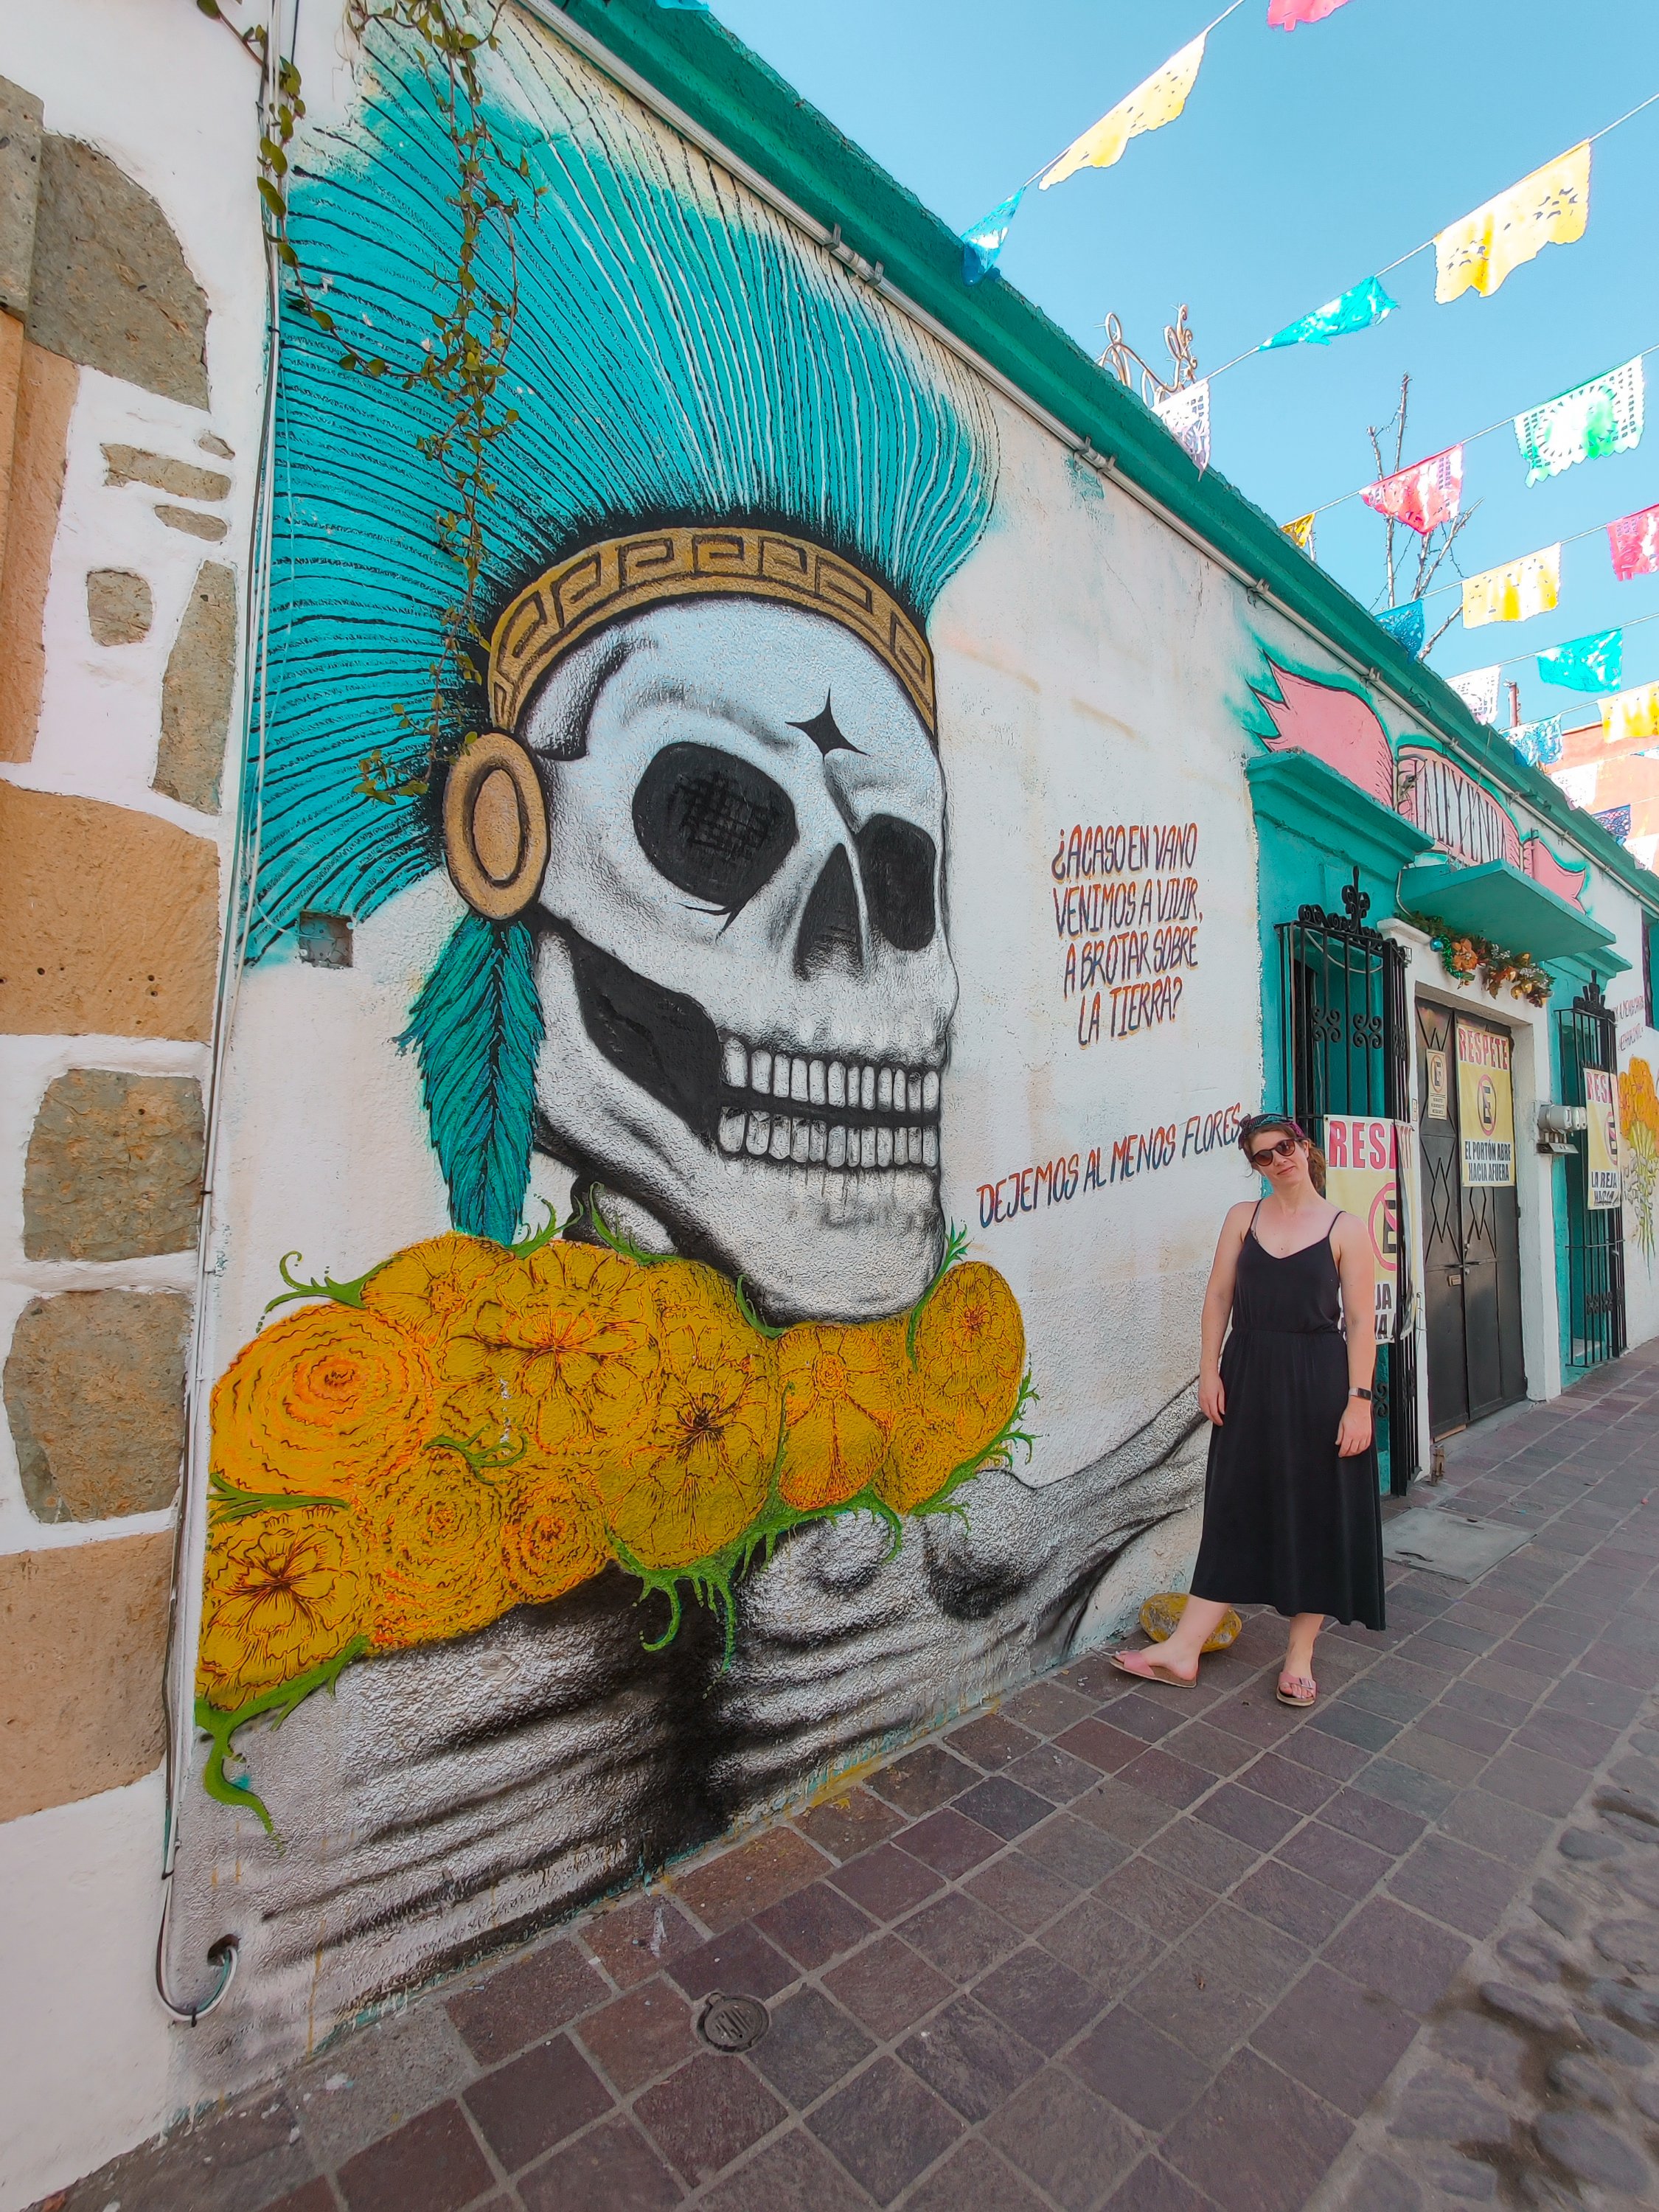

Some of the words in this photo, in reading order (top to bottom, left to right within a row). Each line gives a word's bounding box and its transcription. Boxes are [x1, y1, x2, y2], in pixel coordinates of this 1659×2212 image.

[1051, 824, 1125, 880] ¿ACASO
[1127, 824, 1149, 872] EN
[1153, 822, 1198, 871] VANO
[1053, 880, 1136, 938] VENIMOS
[1138, 878, 1152, 926] A
[1157, 876, 1203, 923] VIVIR,
[1063, 942, 1077, 1000] A
[1080, 930, 1152, 992] BROTAR
[1153, 925, 1198, 973] SOBRE
[1078, 991, 1101, 1046] LA
[1110, 975, 1183, 1038] TIERRA?
[1458, 1028, 1509, 1071] RESPETE
[976, 1153, 1079, 1228] DEJEMOS
[1083, 1147, 1107, 1192] AL
[1110, 1124, 1176, 1183] MENOS
[1182, 1102, 1242, 1158] FLORES
[1465, 1141, 1472, 1160] EL
[1472, 1139, 1496, 1161] PORTÓN
[1497, 1142, 1511, 1161] ABRE
[1469, 1164, 1487, 1181] HACIA
[1488, 1164, 1510, 1181] AFUERA
[1591, 1171, 1599, 1189] LA
[1600, 1171, 1617, 1189] REJA
